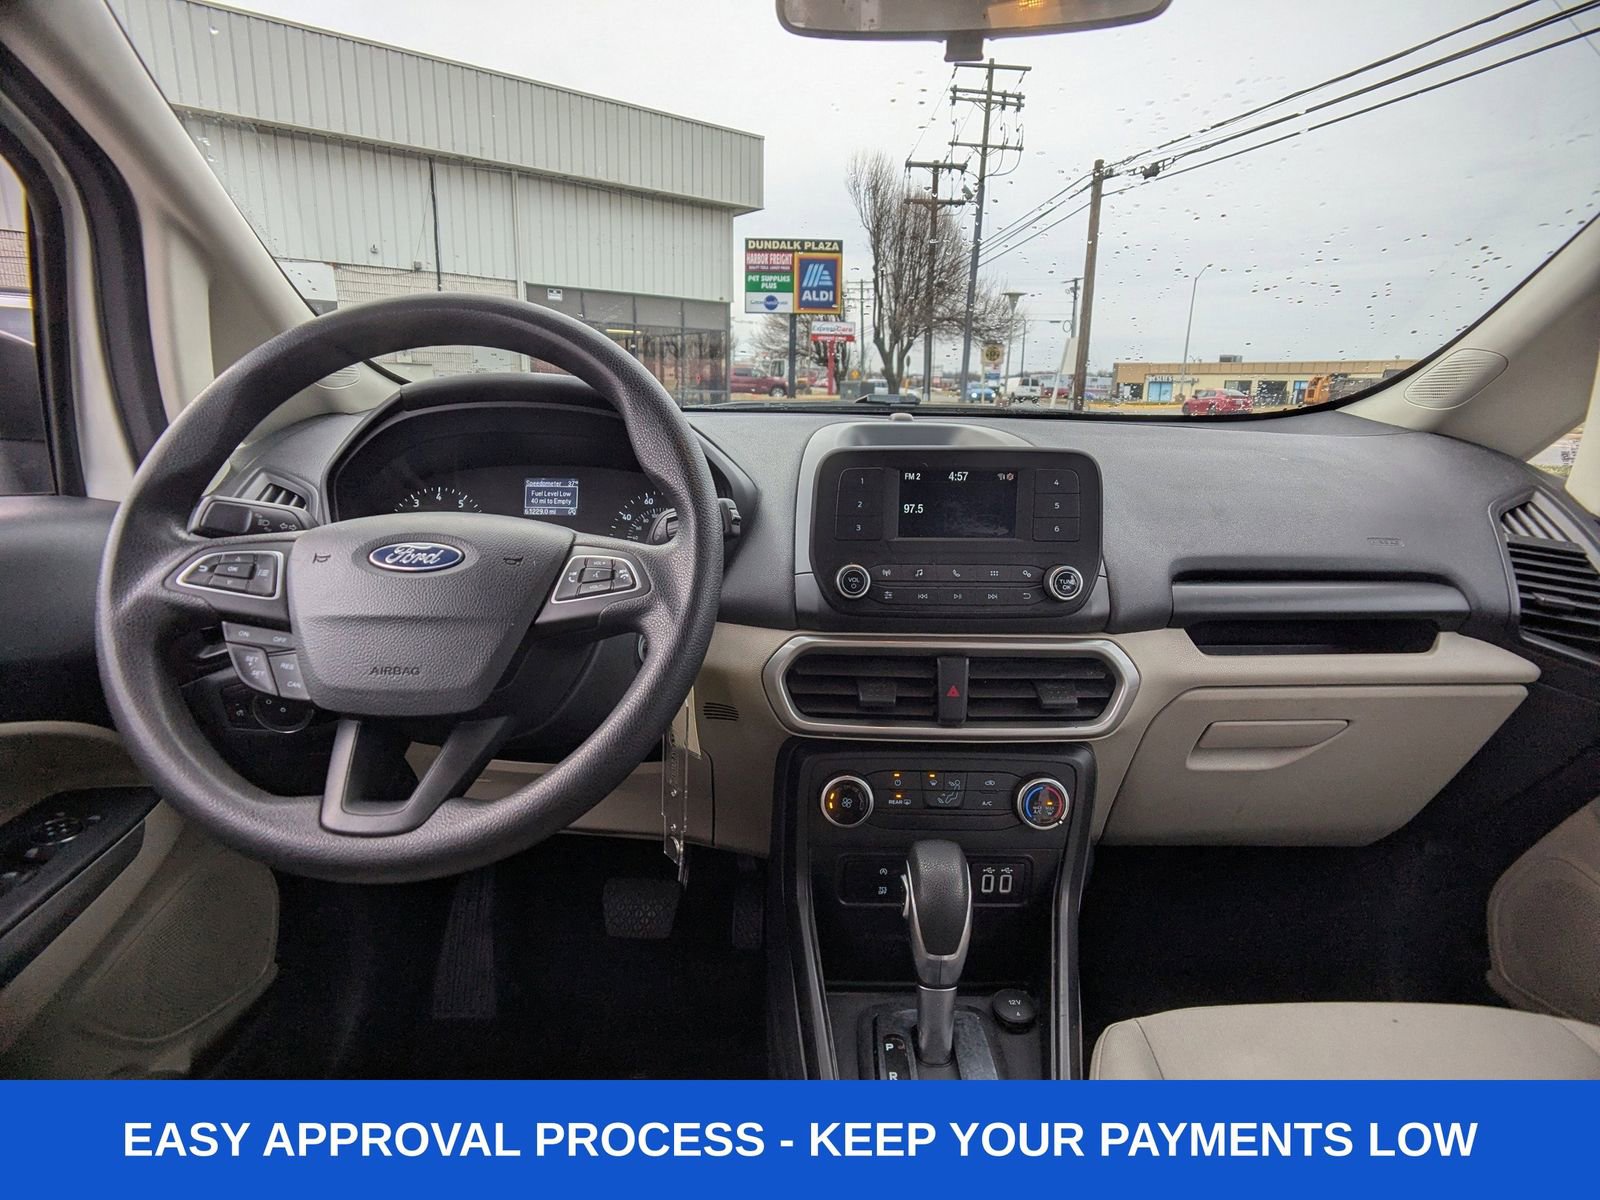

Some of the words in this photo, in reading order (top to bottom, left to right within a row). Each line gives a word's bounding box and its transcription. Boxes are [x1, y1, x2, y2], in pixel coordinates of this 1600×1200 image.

[748, 240, 801, 250] DUNDALK
[804, 241, 839, 250] PLAZA
[746, 253, 769, 265] HARBOR
[769, 253, 793, 265] FREIGHT
[802, 290, 834, 302] ALDI
[904, 472, 915, 480] FM
[915, 472, 921, 480] 2
[948, 471, 969, 481] 4:57
[525, 480, 562, 488] Speedometer
[436, 493, 442, 501] 4
[413, 499, 420, 508] 3
[458, 500, 465, 509] 5
[1054, 502, 1060, 510] 5
[903, 503, 924, 514] 97.5
[385, 544, 444, 564] Ford
[238, 630, 250, 638] ON
[280, 662, 295, 671] RES
[369, 666, 420, 676] AIRBAG
[287, 681, 301, 689] CAN
[886, 1043, 894, 1051] P
[889, 1071, 898, 1080] R
